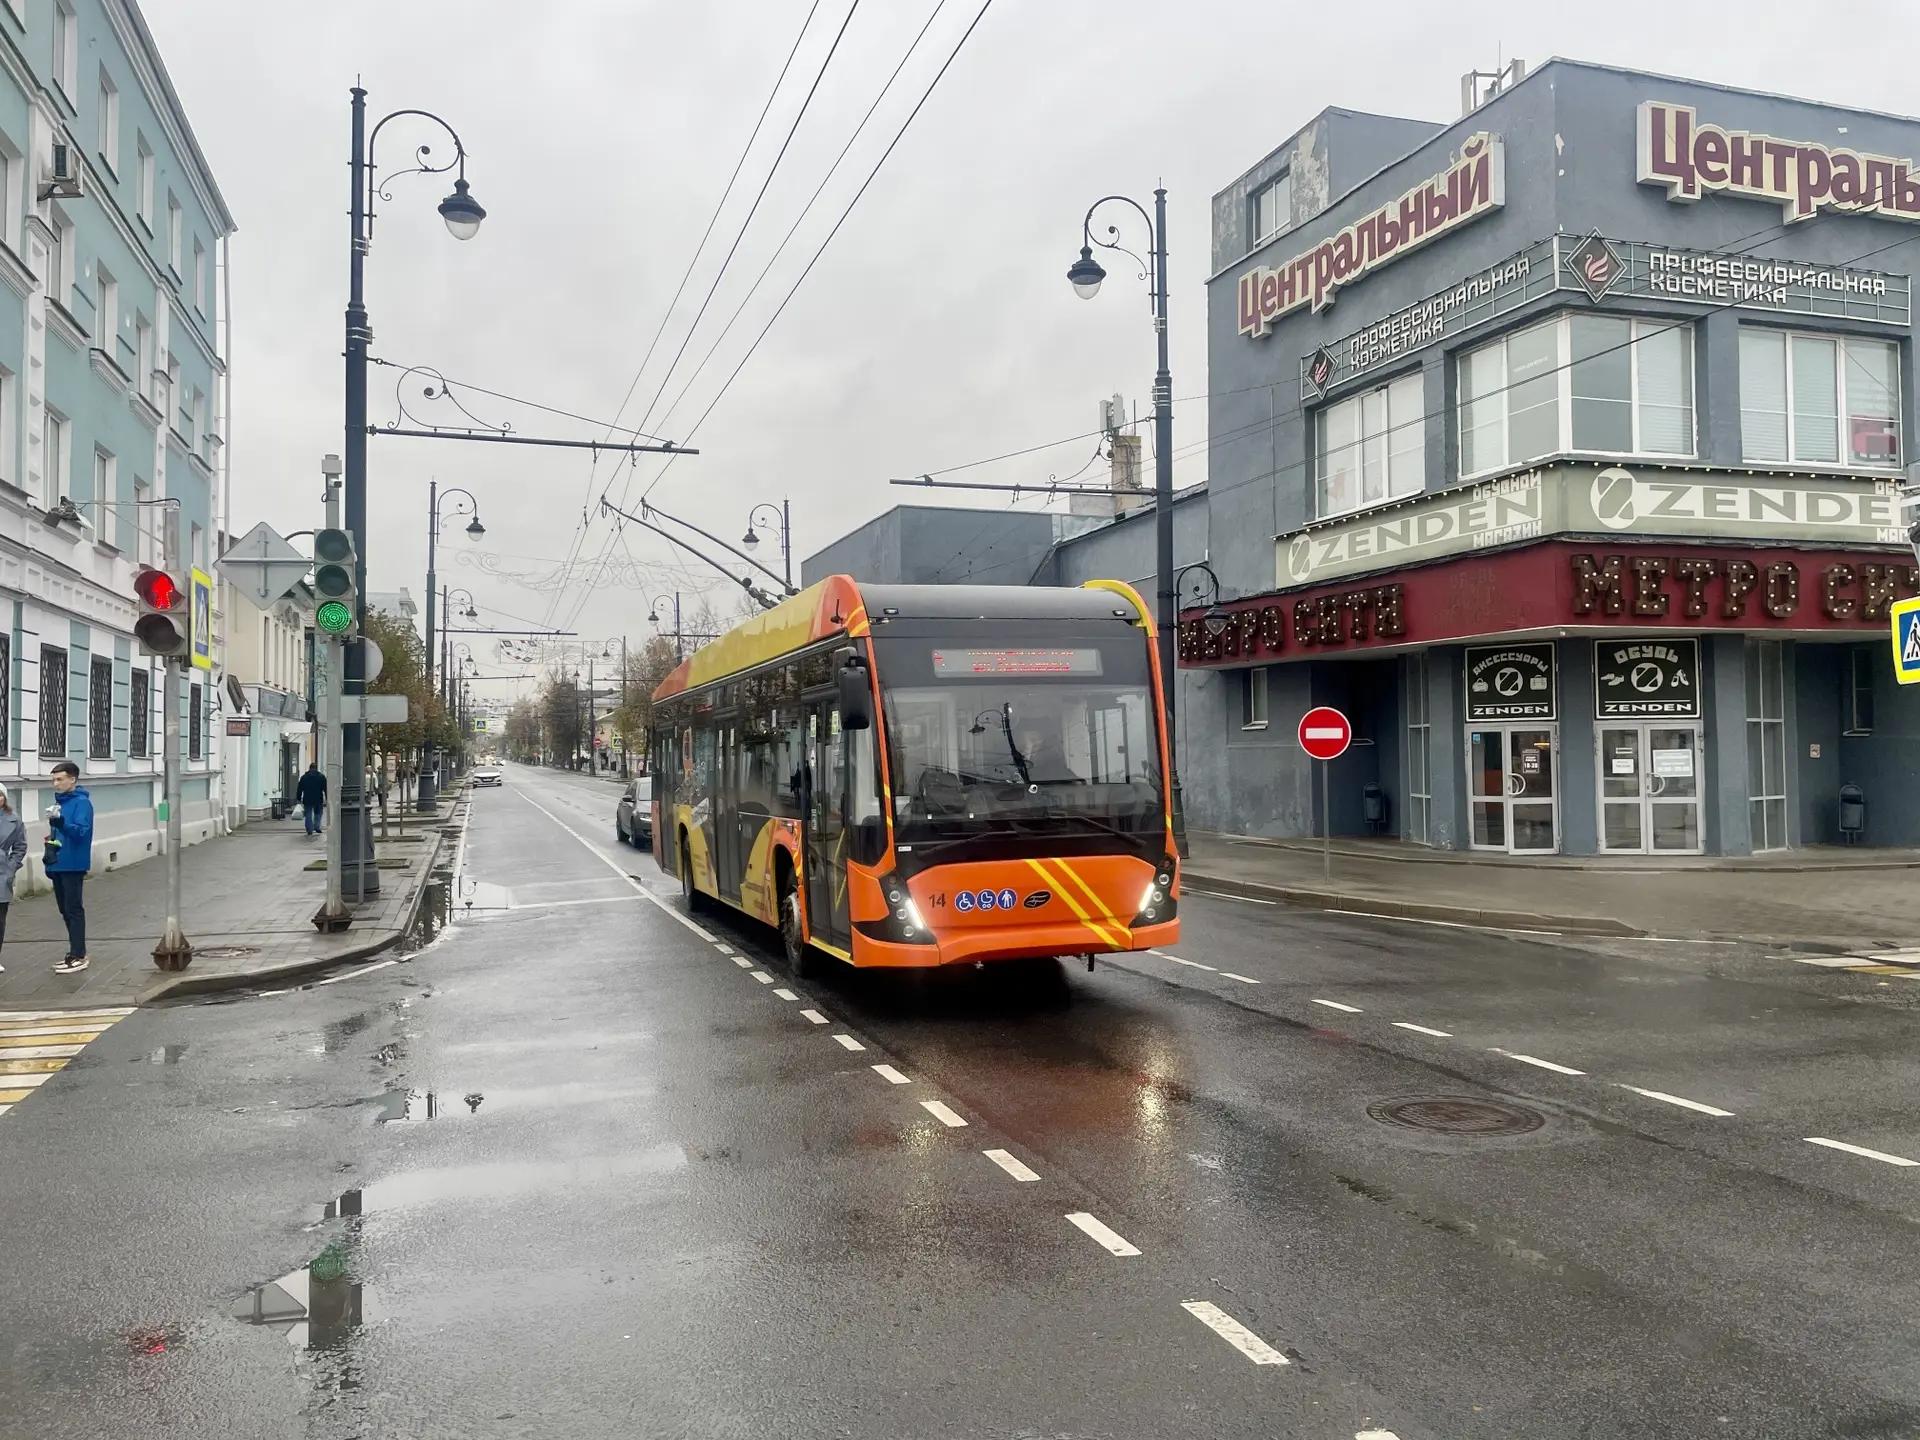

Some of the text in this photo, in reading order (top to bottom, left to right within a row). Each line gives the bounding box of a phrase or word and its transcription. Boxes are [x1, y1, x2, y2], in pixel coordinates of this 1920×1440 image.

[1239, 139, 1490, 334] Центральный
[1650, 253, 1886, 296] ПРОФЕССИОНАЛЬНАЯ
[1650, 273, 1787, 303] КОСМЕТИКА
[1351, 257, 1531, 353] ПРОФЕССИОНАЛЬНАЯ
[1351, 316, 1445, 371] КОСМЕТИКА
[1649, 485, 1905, 525] ZENDE
[1318, 488, 1538, 566] ZENDEN
[1473, 520, 1541, 547] МАГАЗИН
[1877, 527, 1909, 542] МАГ
[1571, 554, 1800, 618] МЕТРО
[1294, 583, 1406, 647] СИТИ
[1614, 645, 1679, 664] ОБУВЬ
[1473, 705, 1549, 716] ZENDEN
[1605, 703, 1691, 713] ZENDEN
[928, 893, 946, 908] 14
